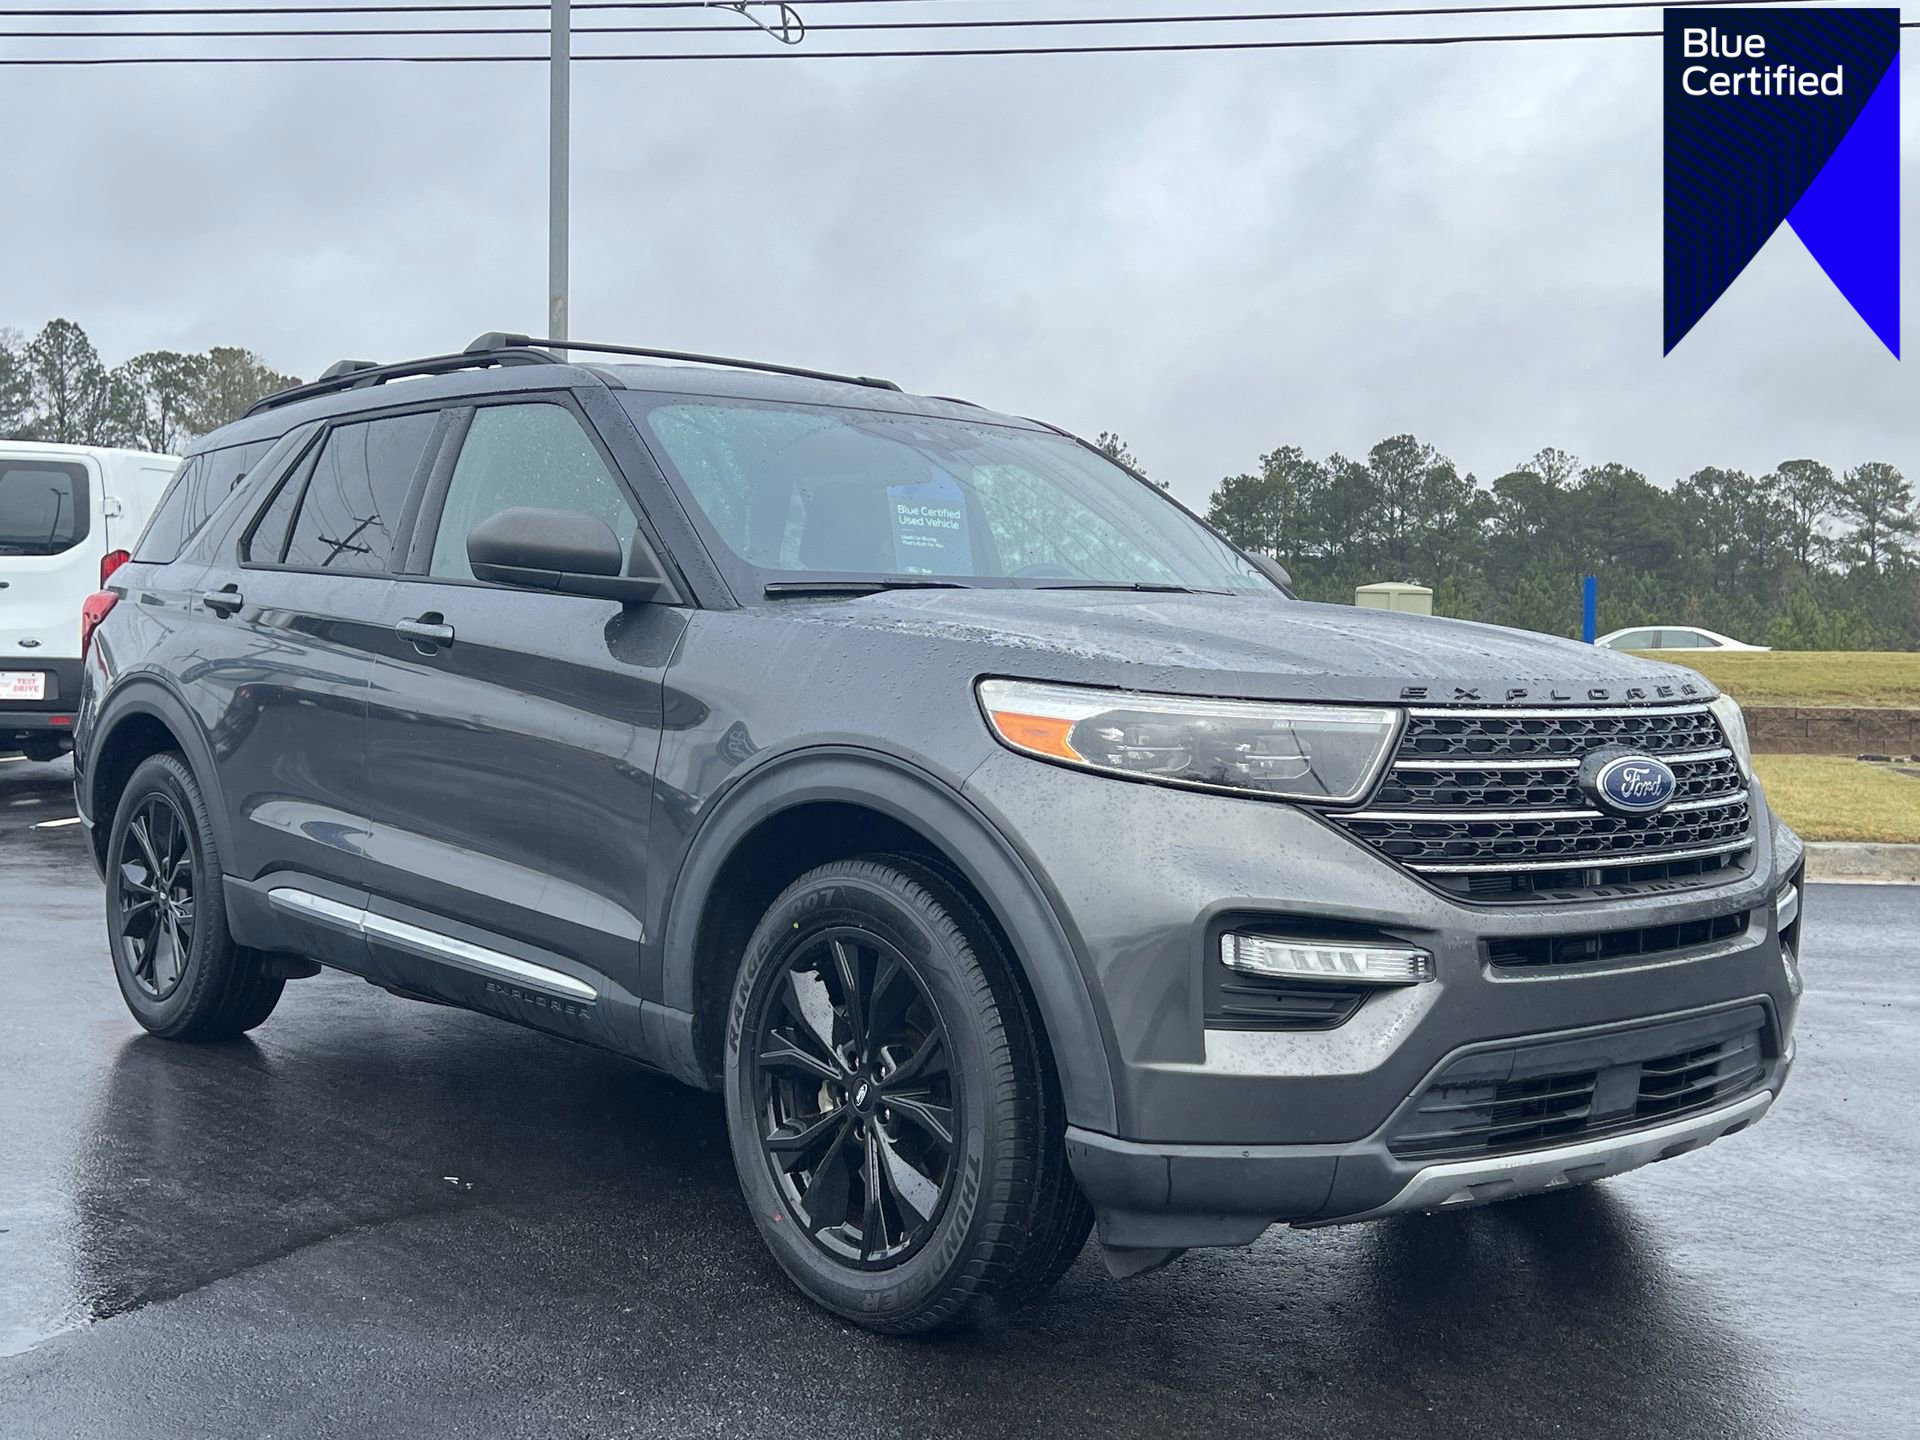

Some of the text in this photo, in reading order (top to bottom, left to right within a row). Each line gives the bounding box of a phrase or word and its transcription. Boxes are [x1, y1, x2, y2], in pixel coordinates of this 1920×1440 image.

[897, 504, 960, 519] Blue Certified
[898, 515, 960, 529] Used Vehicle
[13, 685, 39, 693] DRIVE
[1400, 684, 1698, 700] EXPLORER
[1621, 767, 1662, 798] Ford
[485, 982, 591, 1020] EXPLORER
